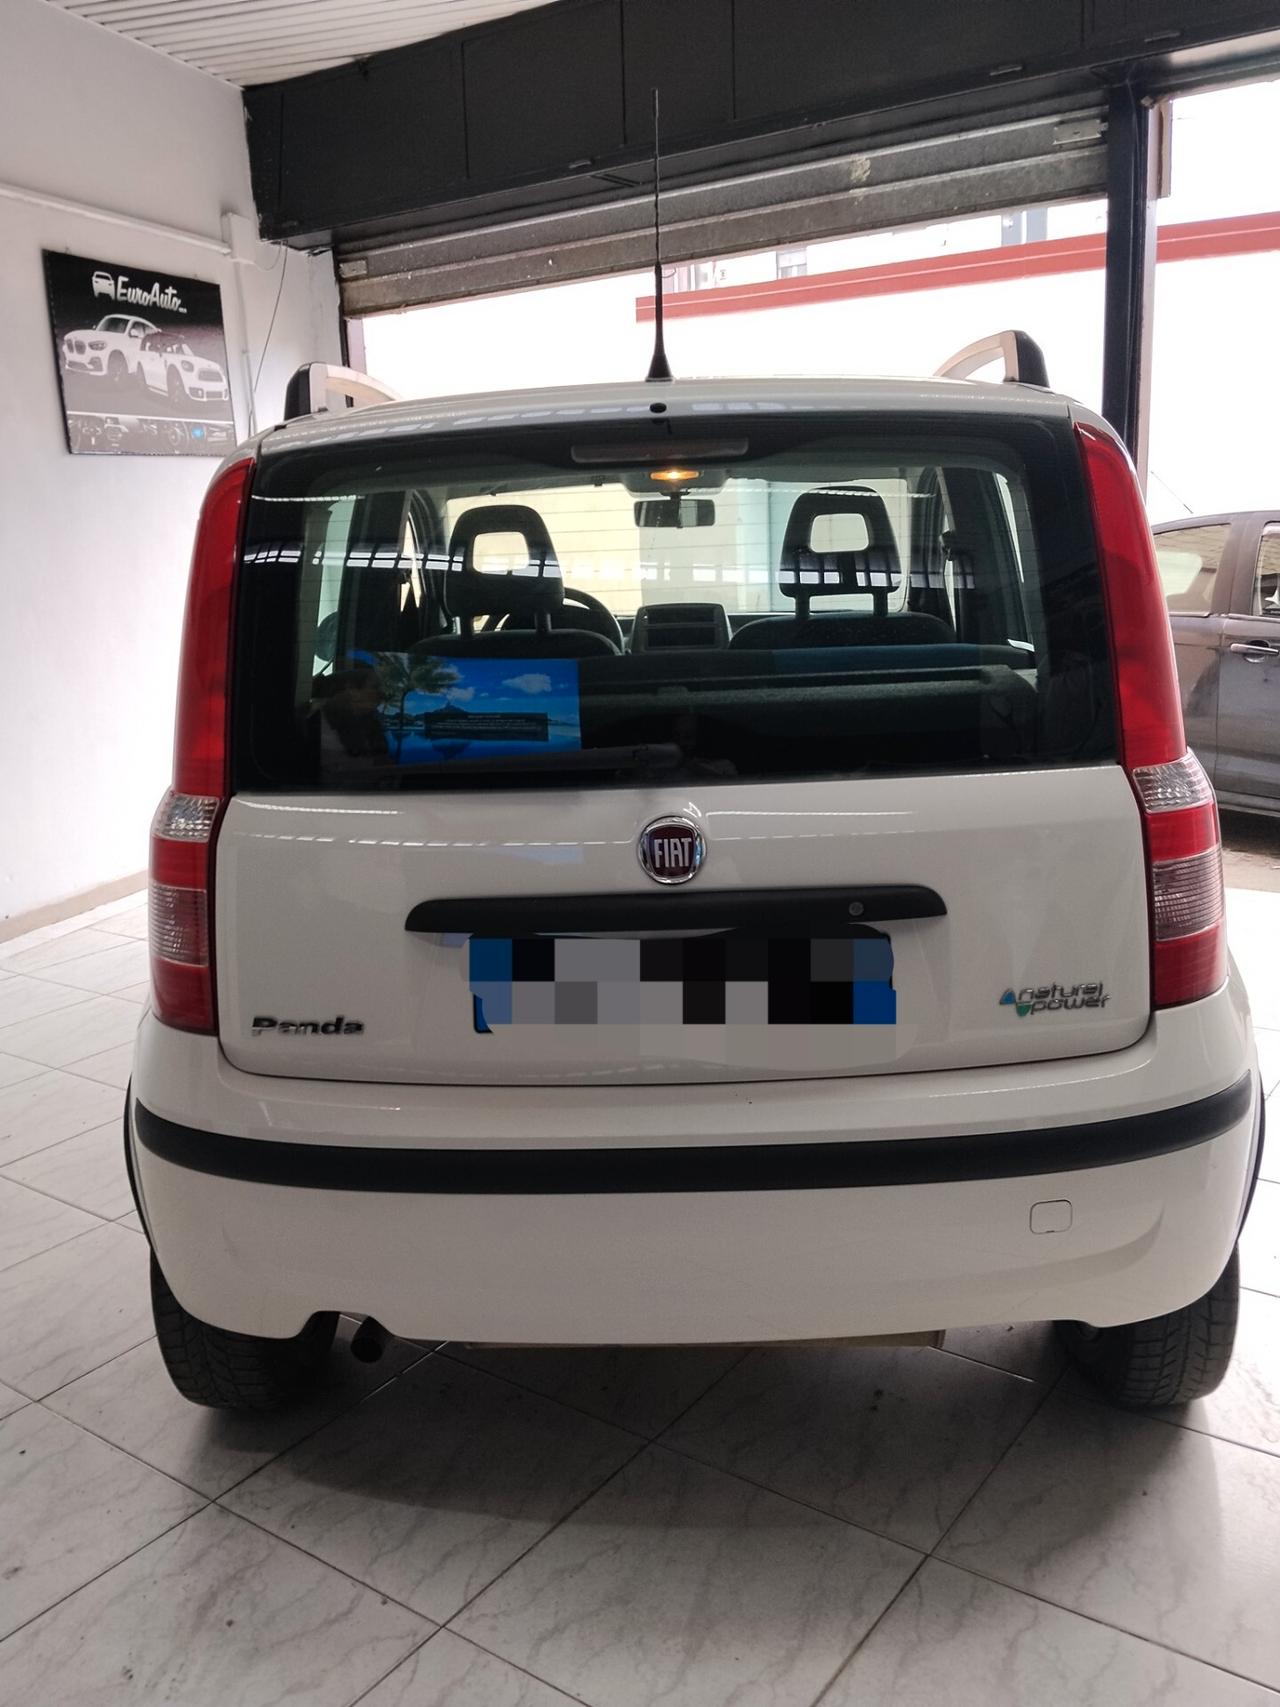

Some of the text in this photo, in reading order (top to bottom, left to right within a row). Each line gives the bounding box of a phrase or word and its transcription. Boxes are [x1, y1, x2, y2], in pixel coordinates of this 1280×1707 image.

[117, 275, 181, 311] EuroAuto
[654, 838, 692, 868] FIAT
[1018, 981, 1104, 1001] natural
[1030, 994, 1111, 1015] power
[251, 1015, 364, 1036] Panda
